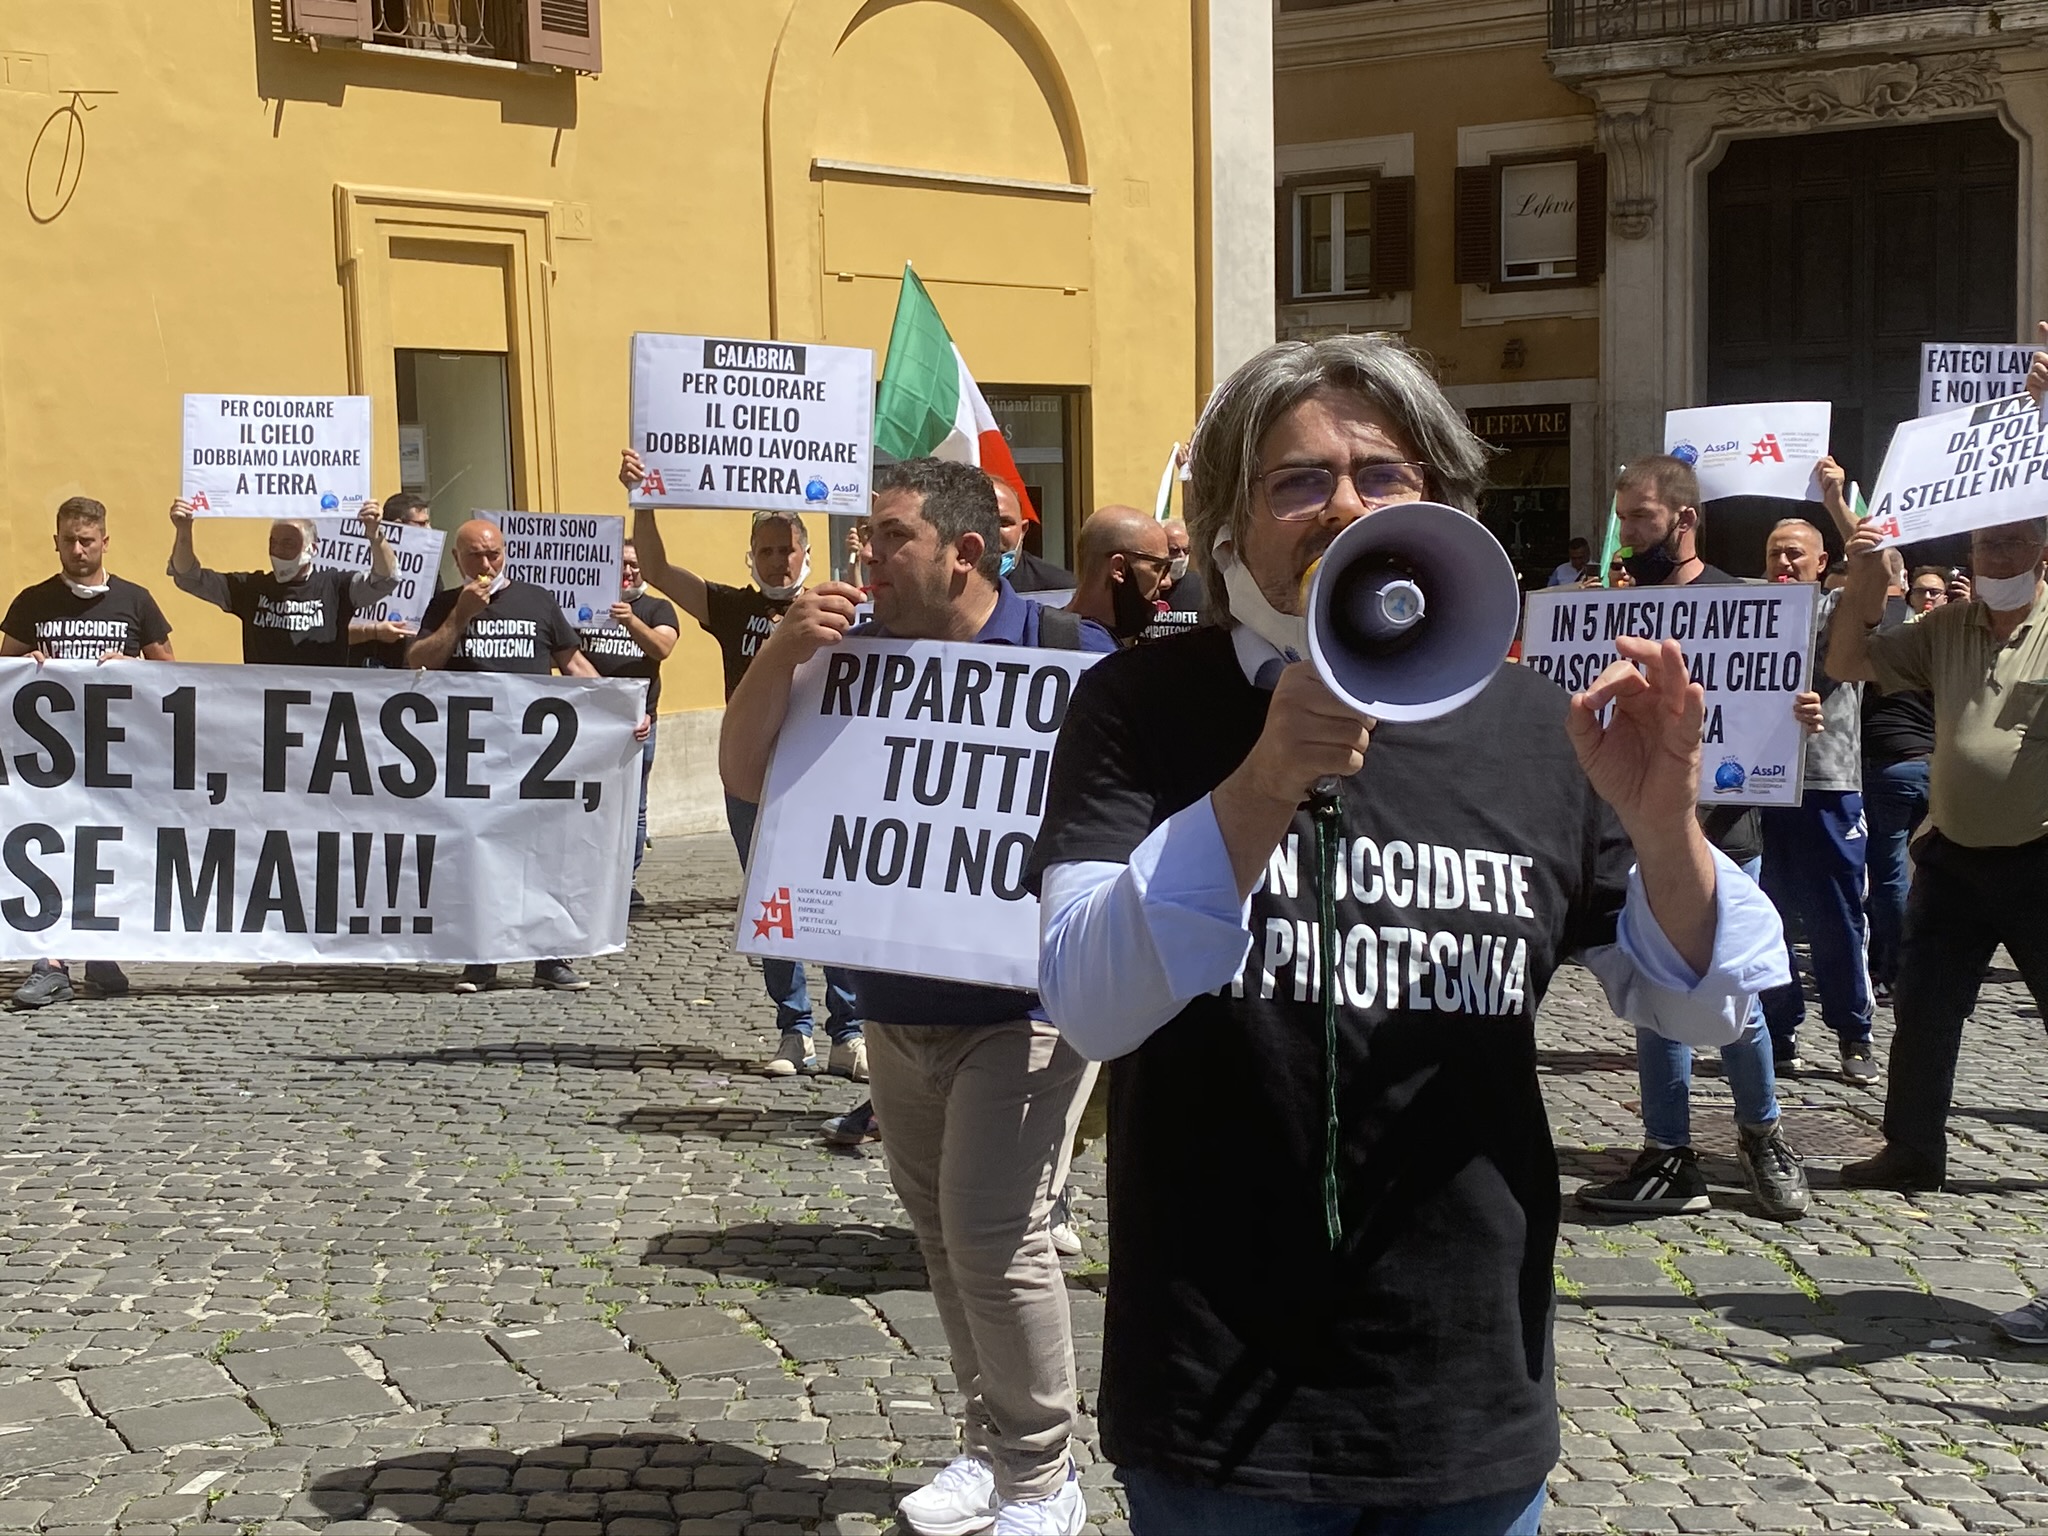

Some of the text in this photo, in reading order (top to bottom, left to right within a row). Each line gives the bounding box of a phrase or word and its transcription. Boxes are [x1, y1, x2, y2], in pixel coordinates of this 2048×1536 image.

[714, 344, 796, 371] CALABRIA
[1927, 350, 2034, 374] FATECI LAV
[682, 372, 826, 402] PER COLORARE
[1931, 380, 1942, 402] E
[1946, 380, 1981, 403] NOI
[221, 399, 334, 418] PER COLORARE
[706, 403, 800, 433] IL CIELO
[1989, 396, 2037, 420] LAZ
[240, 424, 315, 445] IL CIELO
[1472, 412, 1566, 435] LEFEVRE
[1947, 414, 2035, 454] DA POL
[193, 448, 361, 467] DOBBIAMO LAVORARE
[646, 432, 858, 464] DOBBIAMO LAVORARE
[1703, 441, 1740, 453] AssPI
[1954, 434, 2048, 475] DI STEL
[236, 473, 318, 495] A TERRA
[698, 464, 716, 491] A
[723, 465, 801, 495] TERRA
[1875, 492, 1893, 517] A
[1900, 471, 1987, 511] STELLE
[1990, 464, 2019, 492] IN
[508, 516, 556, 537] NOSTRI
[560, 518, 597, 538] SONO
[317, 538, 354, 563] TATE
[505, 540, 614, 566] CHI ARTIFICIALI,
[550, 566, 600, 586] FUOCHI
[65, 620, 128, 638] UCCIDETE
[477, 619, 537, 636] UCCIDETE
[1552, 599, 1782, 642] IN 5 MESI CI AVETE
[465, 638, 534, 658] PIROTECNIA
[741, 633, 757, 657] LA
[1726, 651, 1802, 692] CIELO
[820, 652, 1086, 733] RIPARTO
[0, 680, 603, 813] SE 1, FASE 2,
[884, 736, 1050, 817] TUTTI
[1750, 764, 1786, 776] AssPI
[823, 814, 1037, 903] NOI NO
[154, 826, 437, 935] MAI!!!
